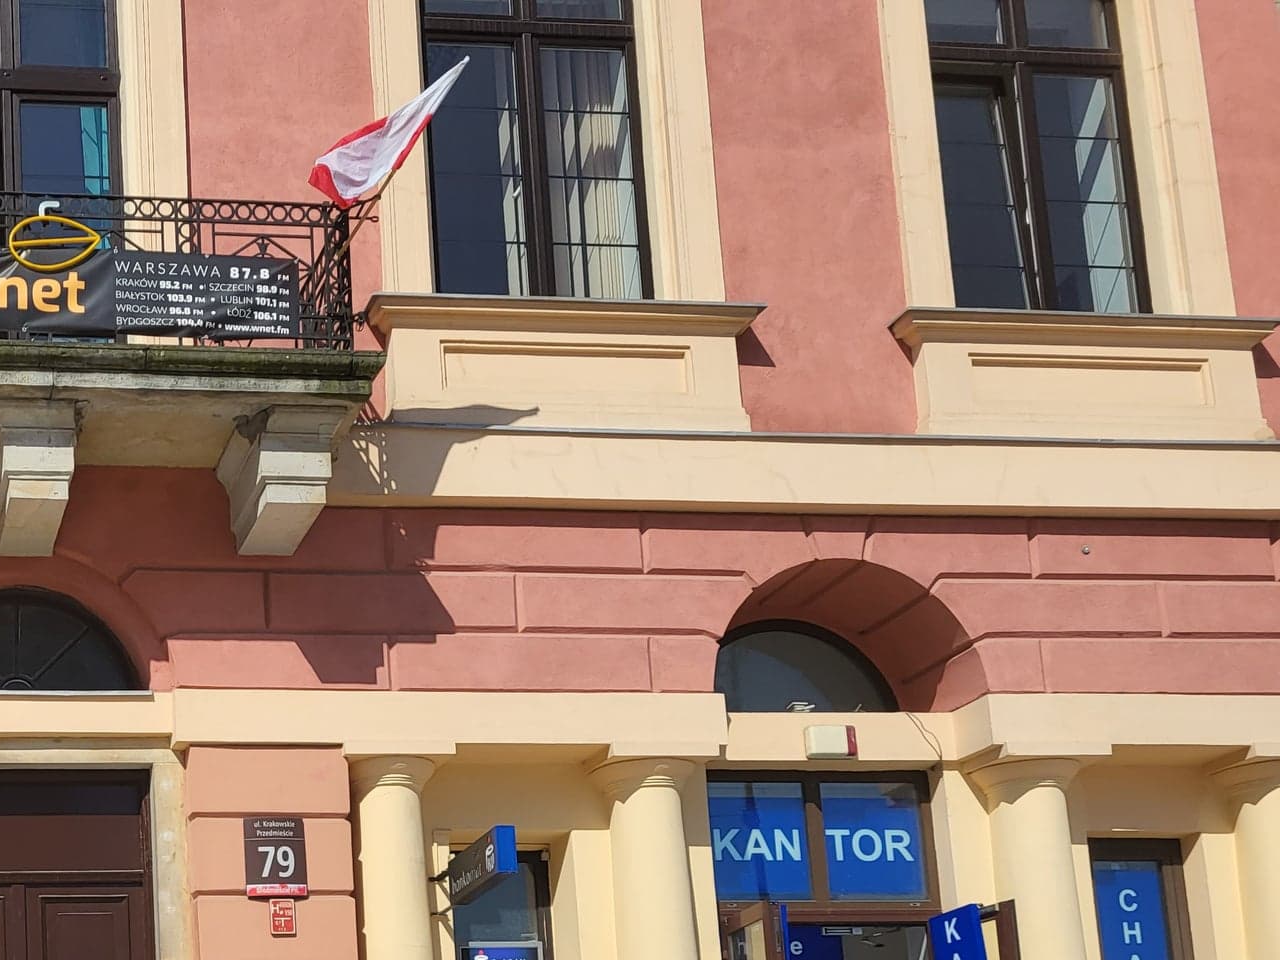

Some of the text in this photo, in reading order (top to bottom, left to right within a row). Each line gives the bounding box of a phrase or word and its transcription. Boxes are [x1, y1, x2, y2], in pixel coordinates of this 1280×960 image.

[115, 261, 221, 278] WARSZAWA
[229, 266, 270, 280] 87.8
[115, 277, 158, 288] KRAKÓW
[159, 280, 180, 290] 95.2
[209, 283, 254, 292] SZCZECIN
[115, 291, 165, 301] BIAŁYSTOK
[166, 293, 192, 303] 103.9
[220, 295, 253, 305] LUBLIN
[255, 297, 277, 307] 101.1
[116, 304, 167, 314] WROCŁAW
[169, 306, 191, 315] 96.8
[227, 306, 253, 319] ŁÓDŹ
[253, 310, 277, 320] 106.1
[116, 317, 174, 326] BYDGOSZCZ
[176, 318, 203, 327] 104.4
[225, 323, 290, 335] www.wnet.fm
[253, 820, 295, 828] ul. Krakowskie
[256, 829, 293, 838] Przedmieście
[257, 845, 295, 878] 79
[452, 863, 482, 895] bankomat
